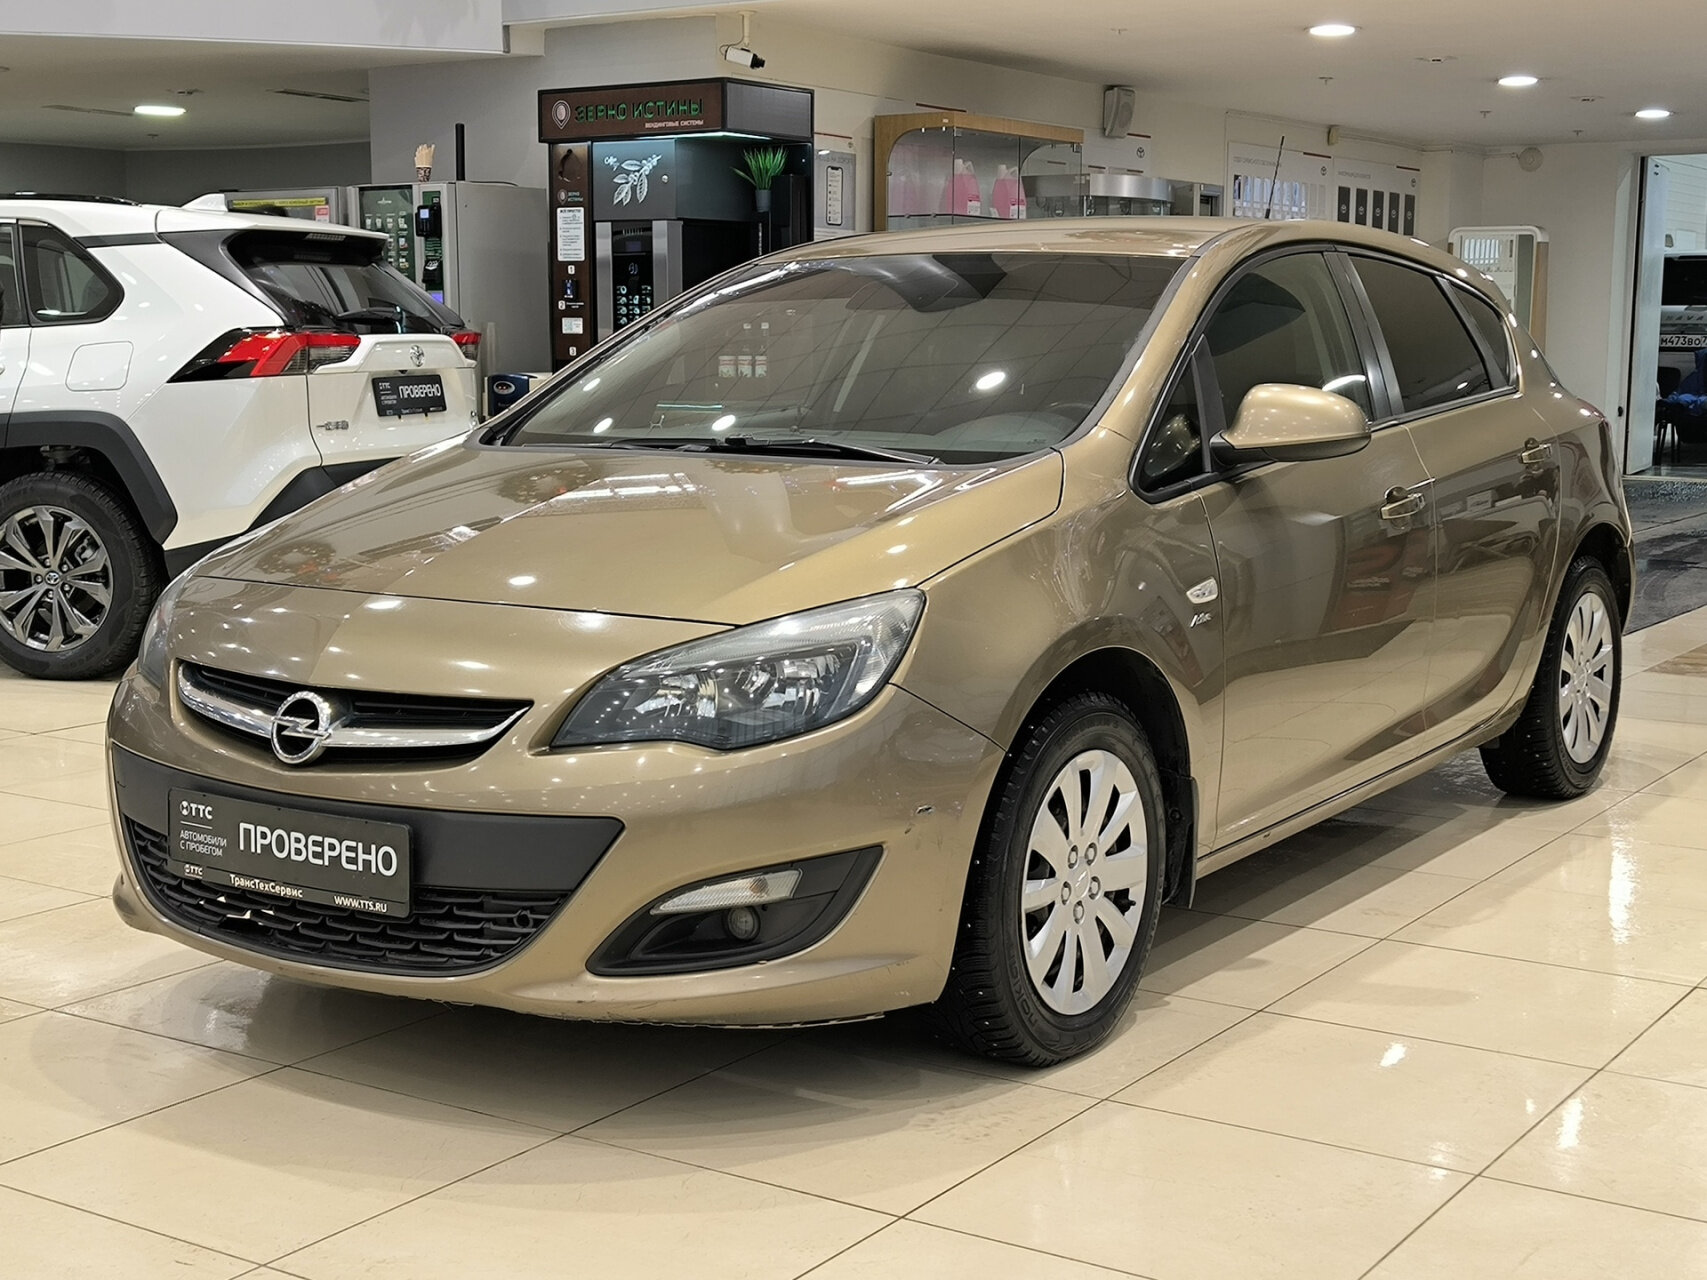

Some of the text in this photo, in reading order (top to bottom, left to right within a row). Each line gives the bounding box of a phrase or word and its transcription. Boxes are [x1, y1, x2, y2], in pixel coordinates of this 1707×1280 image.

[575, 99, 704, 123] ЗЕРНО ИСТИНЫ
[398, 383, 441, 399] ПРОВЕРЕНО
[189, 803, 213, 820] ТТС
[180, 829, 227, 847] АВТОМОБИЛИ
[180, 840, 223, 857] С ПРОБЕГОМ
[239, 822, 398, 877] ПРОВЕРЕНО
[229, 873, 303, 898] ТрансТехСервис
[333, 895, 388, 913] WWW.TTS.RU
